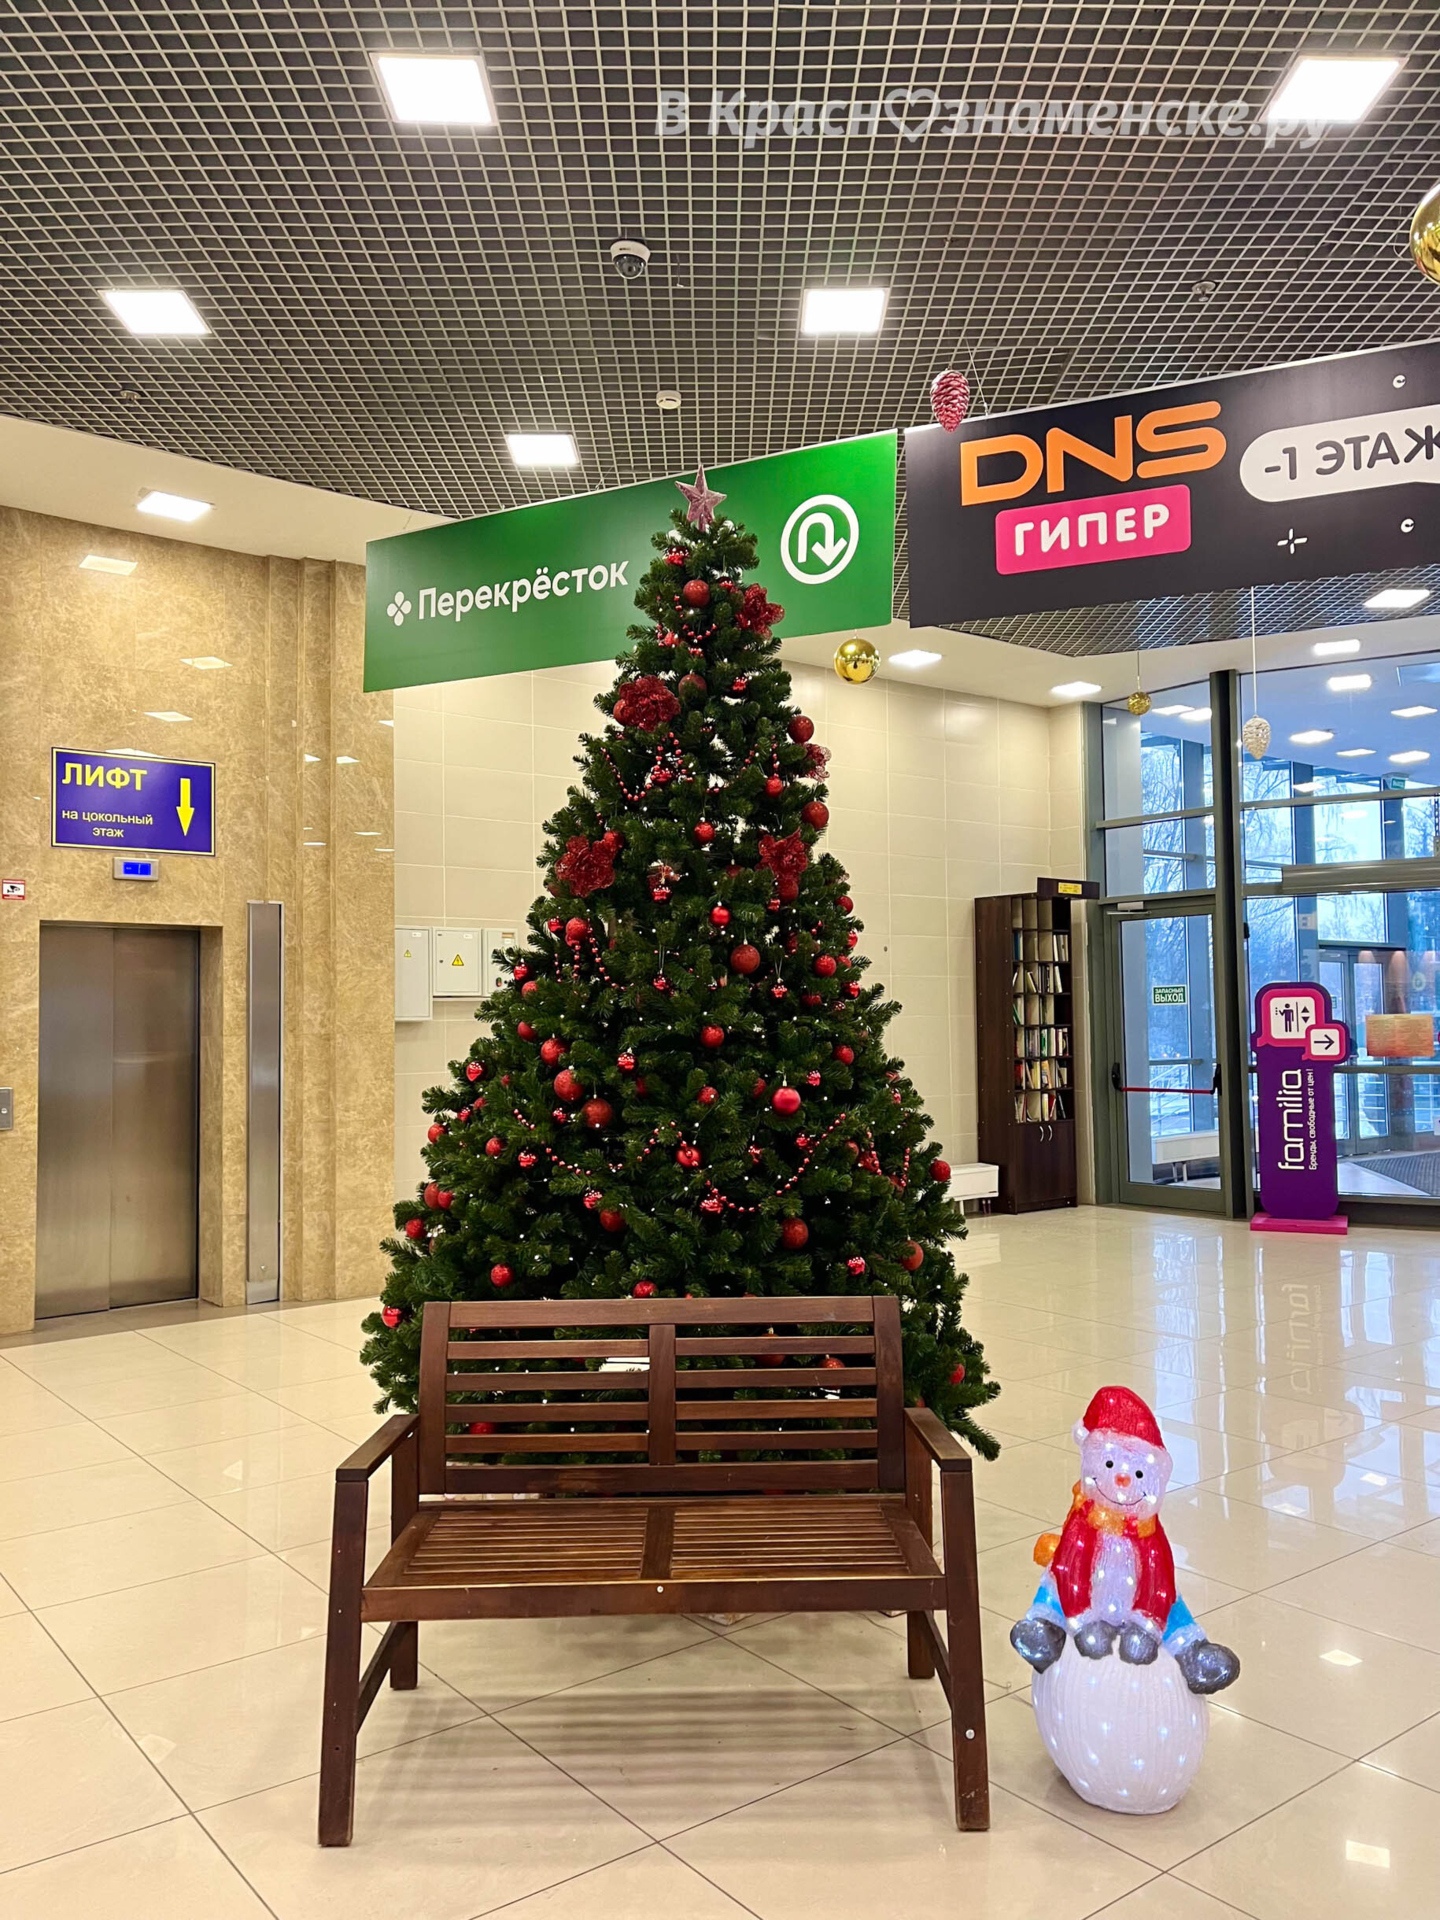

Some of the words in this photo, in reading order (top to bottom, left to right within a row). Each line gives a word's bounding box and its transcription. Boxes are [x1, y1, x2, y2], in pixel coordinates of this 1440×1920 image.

[960, 401, 1227, 506] DNS
[1264, 446, 1297, 480] -1
[1315, 425, 1440, 476] ЭТАЖ
[1014, 503, 1170, 556] ГИПЕР
[417, 560, 629, 622] Перекрёсток
[61, 762, 148, 791] ЛИФТ
[62, 809, 78, 820] на
[82, 810, 153, 825] цокольный
[92, 826, 124, 838] этаж
[1155, 993, 1184, 1003] ВЫХОД
[1308, 1087, 1315, 1096] от
[1276, 1068, 1305, 1170] familia
